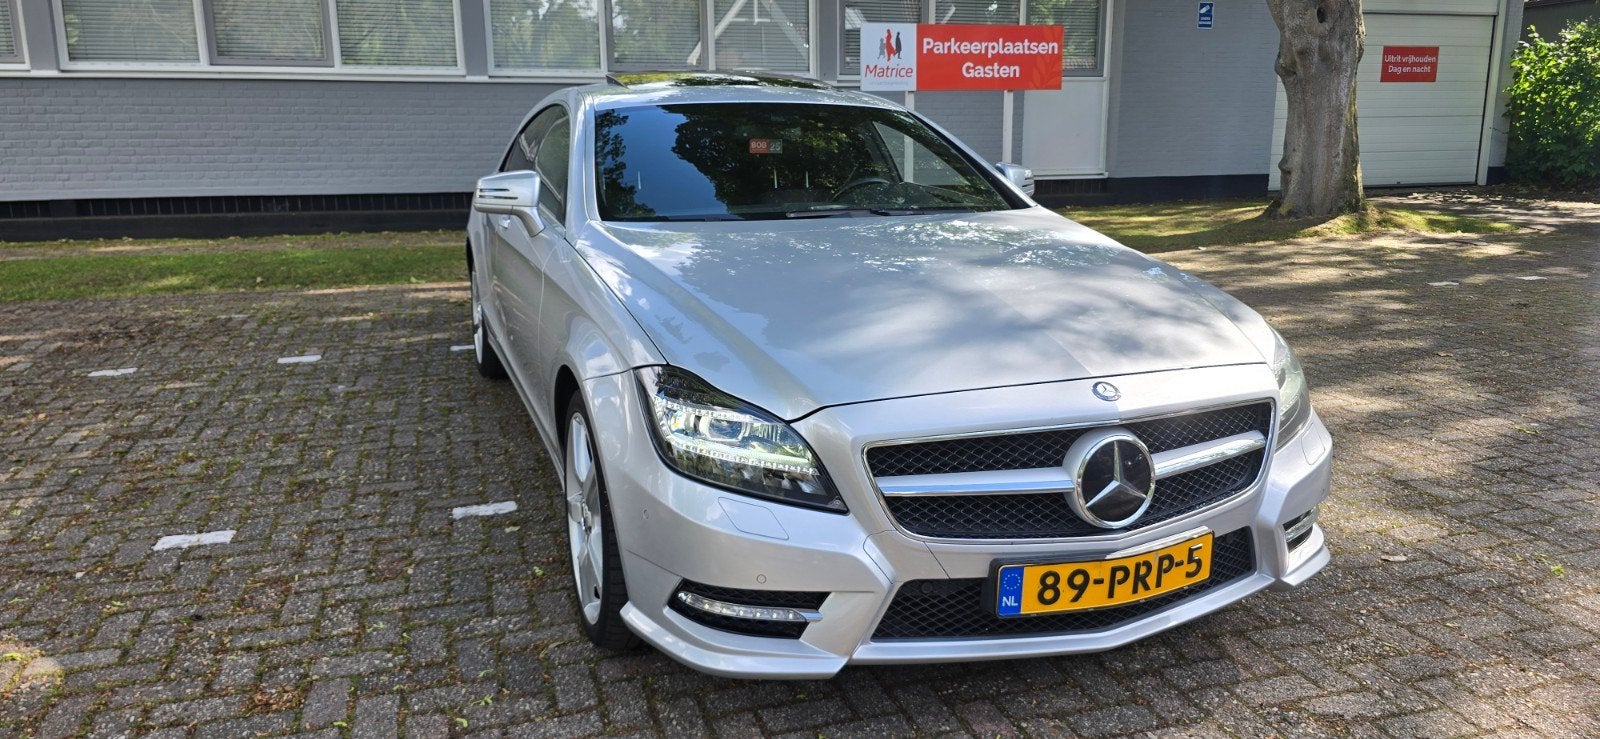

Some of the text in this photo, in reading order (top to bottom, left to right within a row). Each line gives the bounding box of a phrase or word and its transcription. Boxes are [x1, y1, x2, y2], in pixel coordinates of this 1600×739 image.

[922, 37, 1059, 58] Parkeerplaatsen
[1384, 54, 1437, 64] Uitrit vrijhouden
[864, 64, 913, 78] Matrice
[961, 62, 1020, 78] Gasten
[1388, 65, 1402, 75] Dag
[1412, 65, 1431, 73] nacht
[1037, 543, 1203, 606] 89-PRP-5
[1002, 595, 1019, 607] NL
